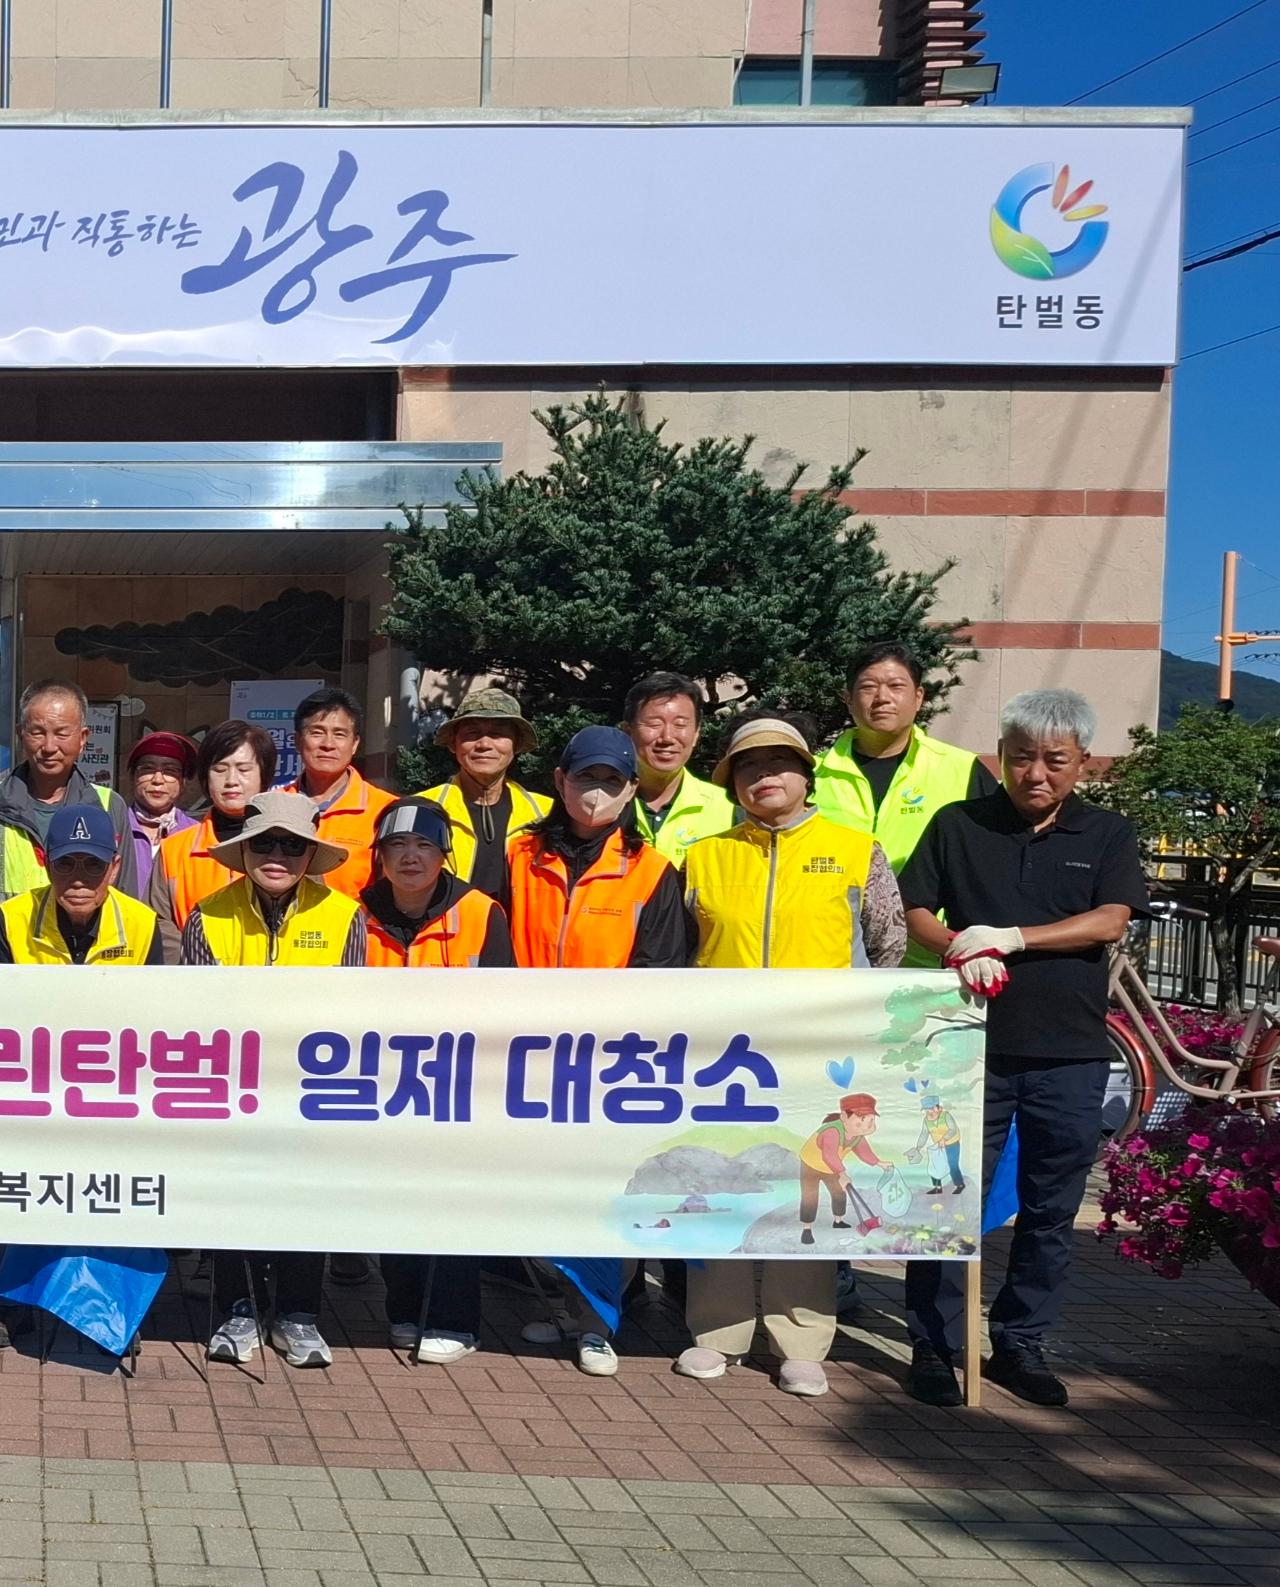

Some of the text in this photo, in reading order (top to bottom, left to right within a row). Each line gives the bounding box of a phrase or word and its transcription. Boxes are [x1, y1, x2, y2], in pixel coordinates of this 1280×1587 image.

[71, 209, 202, 256] 직통하는
[180, 150, 520, 345] 광주
[996, 295, 1104, 330] 탄벌동
[69, 817, 91, 839] A
[297, 1030, 476, 1123] 일제
[505, 1032, 780, 1124] 대청소
